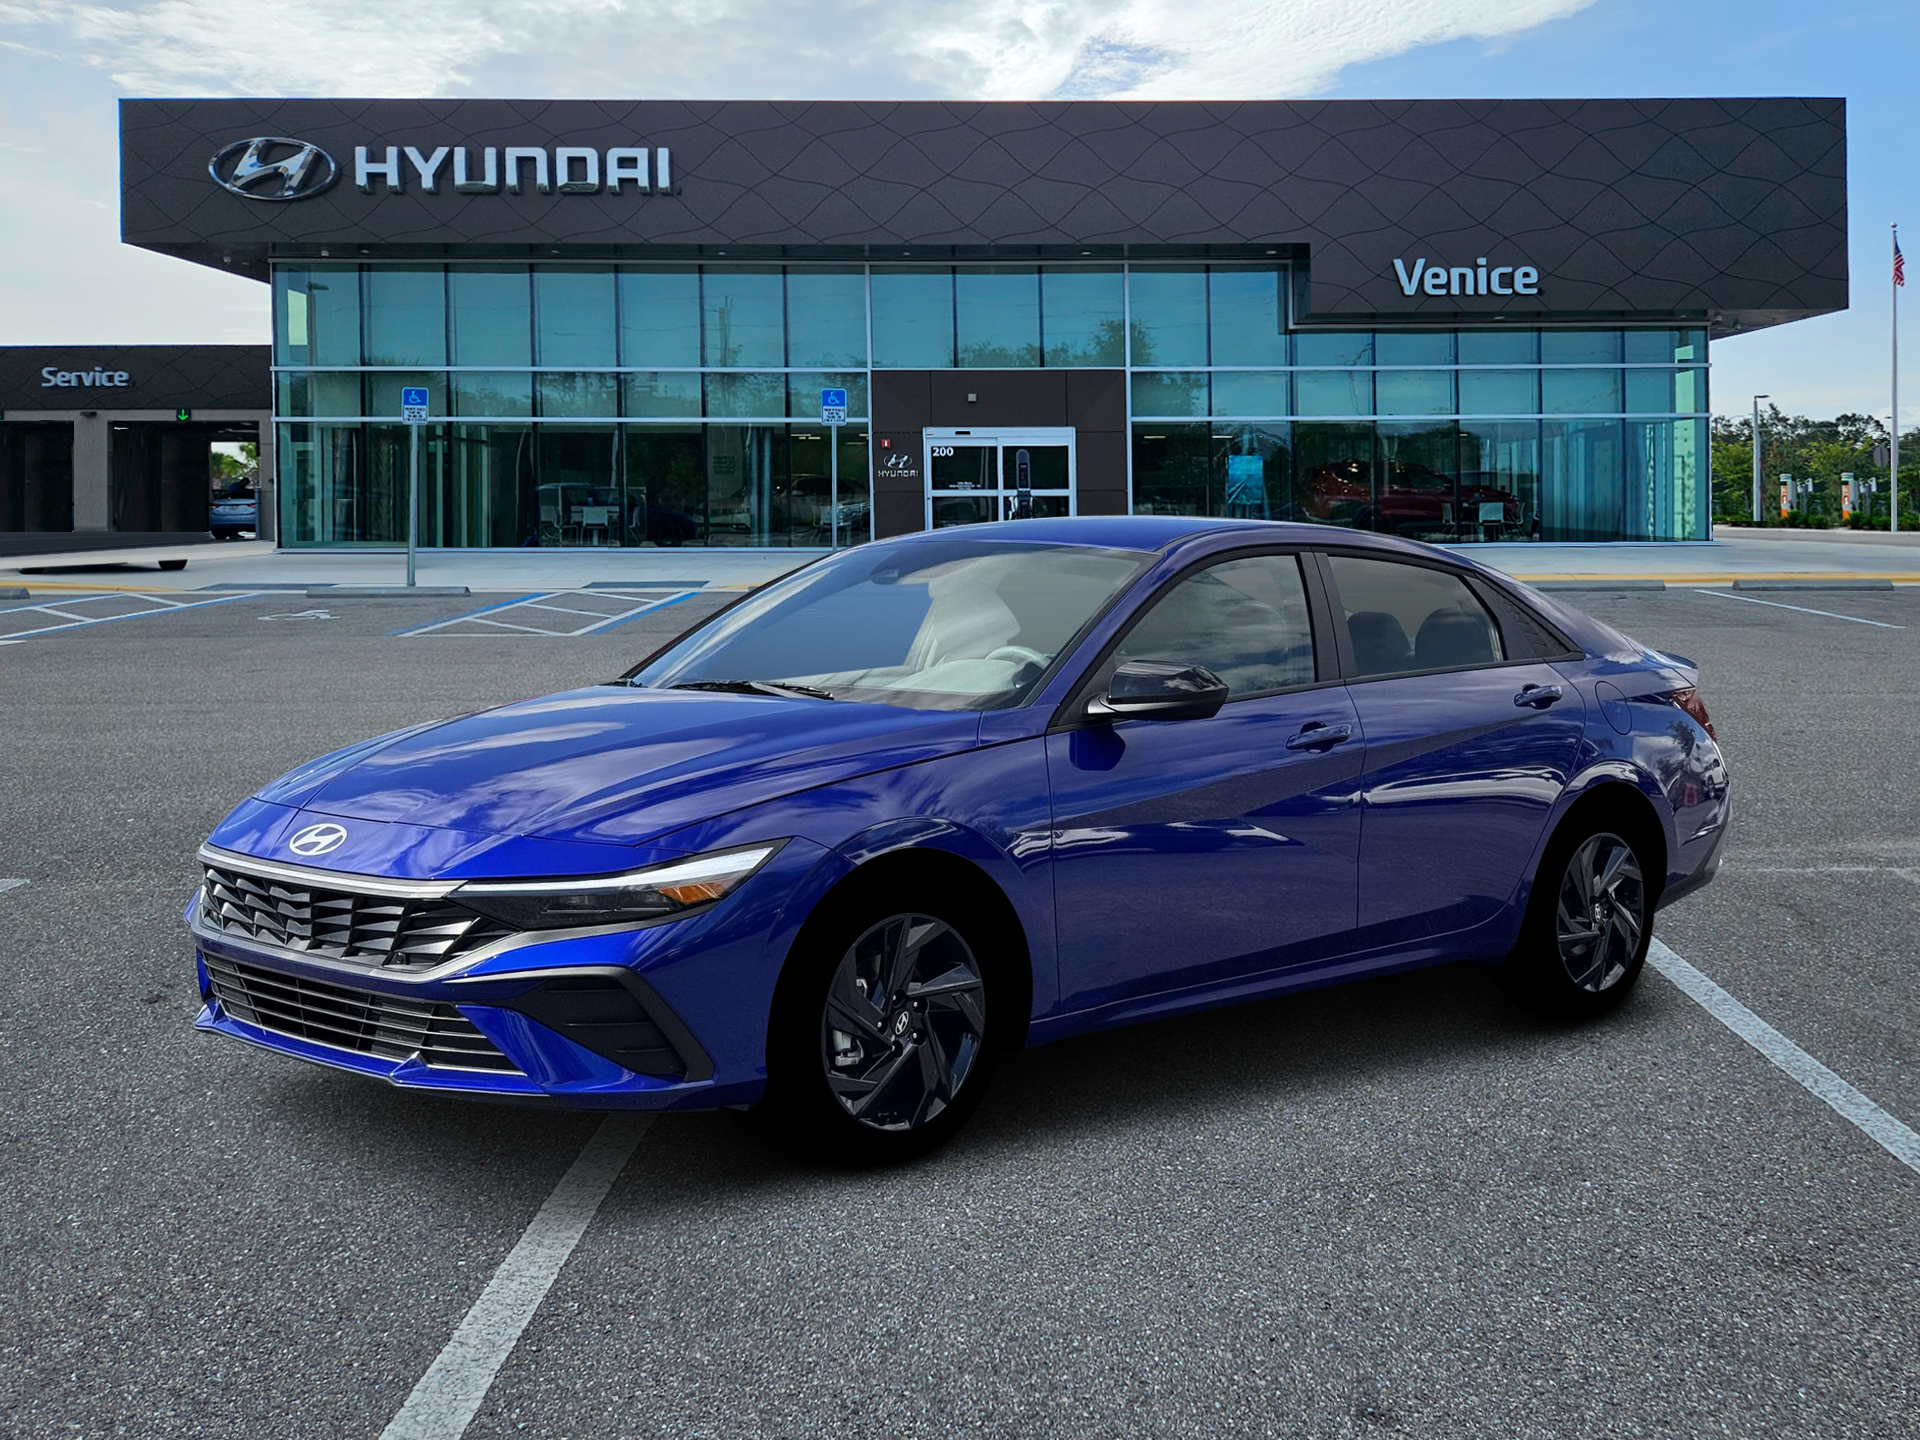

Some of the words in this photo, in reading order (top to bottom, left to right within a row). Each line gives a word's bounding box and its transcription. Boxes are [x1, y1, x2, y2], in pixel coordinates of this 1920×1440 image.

[355, 146, 672, 194] HYUNDAI
[1393, 257, 1539, 296] Venice
[41, 366, 130, 387] Service
[932, 447, 954, 457] 200
